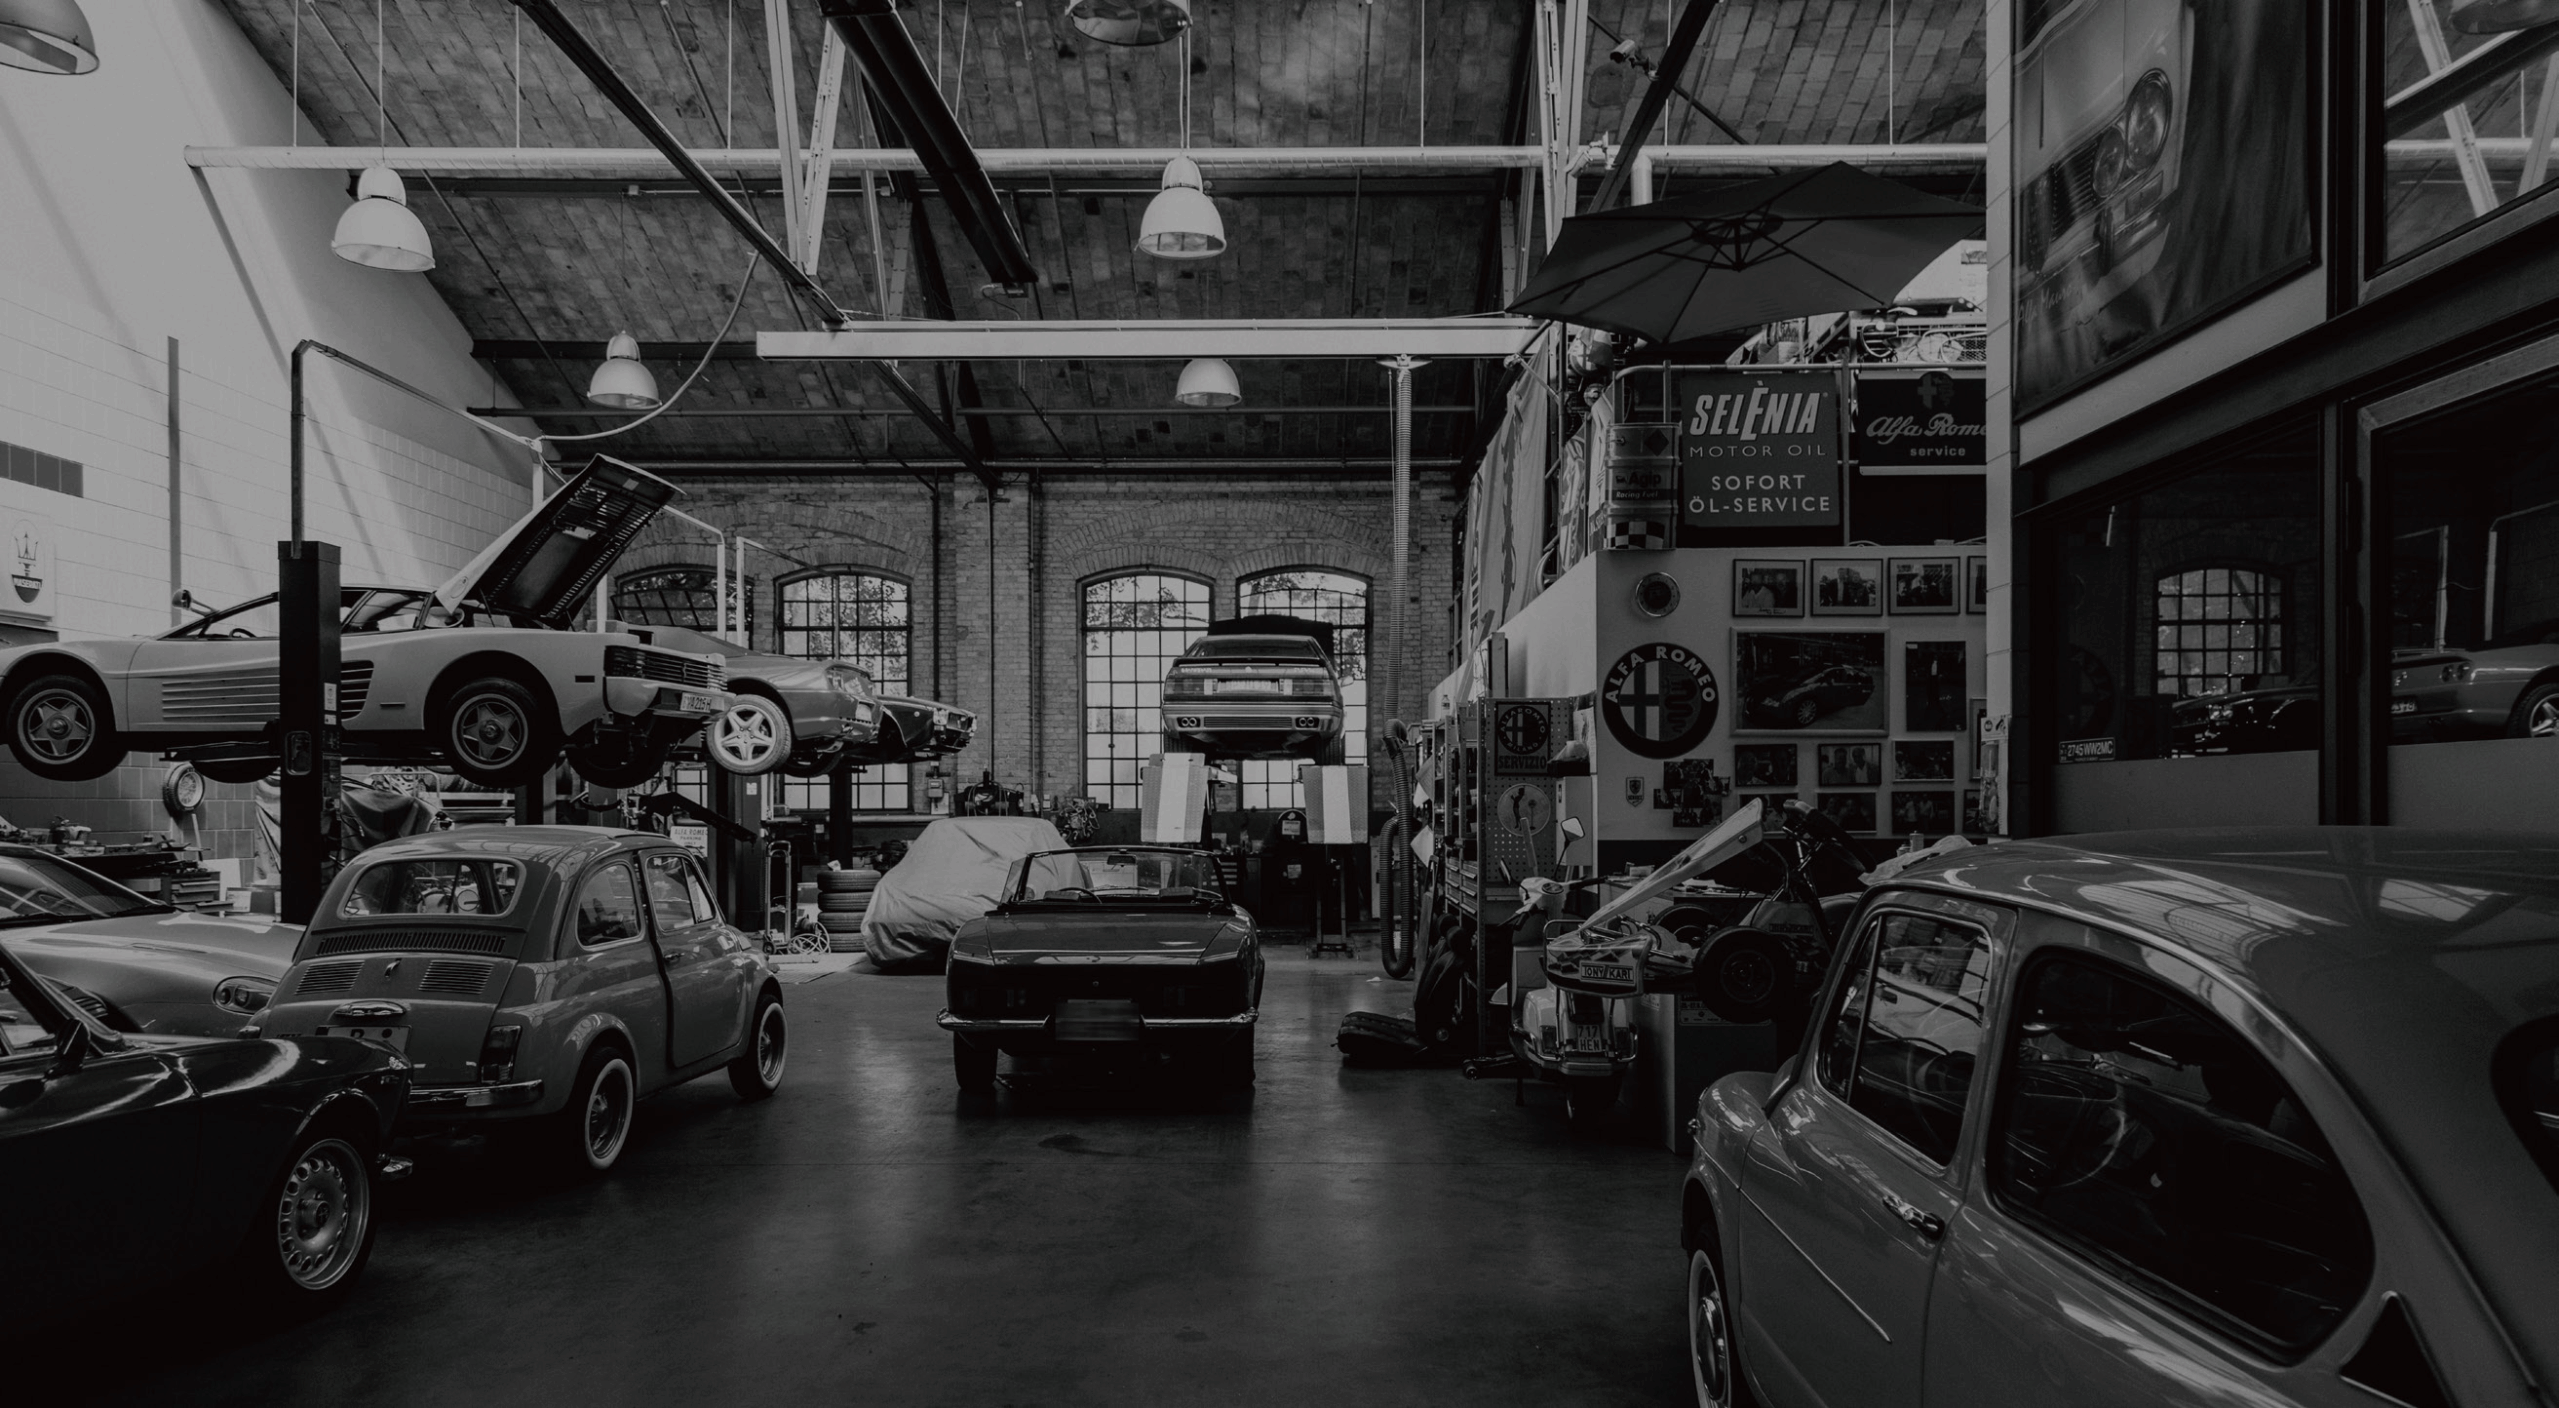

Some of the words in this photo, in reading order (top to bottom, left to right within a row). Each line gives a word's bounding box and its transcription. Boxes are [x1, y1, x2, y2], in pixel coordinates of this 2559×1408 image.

[1689, 380, 1820, 441] SELÈNIA
[1866, 415, 1923, 445] Alfa
[1924, 412, 1986, 437] Rome
[1689, 446, 1773, 458] MOTOR
[1788, 444, 1826, 456] OIL
[1910, 445, 1966, 457] service
[1629, 471, 1661, 488] Agip
[1711, 475, 1806, 491] SOFORT
[1616, 490, 1640, 499] Racing
[1641, 490, 1658, 498] Fuel
[1689, 495, 1830, 513] ÖL-SERVICE
[1605, 652, 1645, 704] ALFA
[1655, 645, 1716, 703] ROMEO
[1500, 710, 1517, 732] ALFA
[1517, 707, 1546, 734] ROMEO
[1506, 742, 1538, 752] MILANO
[1498, 755, 1547, 769] SERVIZIO
[1583, 966, 1604, 977] TONY
[1609, 969, 1632, 980] KART
[1578, 1025, 1598, 1037] 717
[1580, 1039, 1600, 1051] HEN
